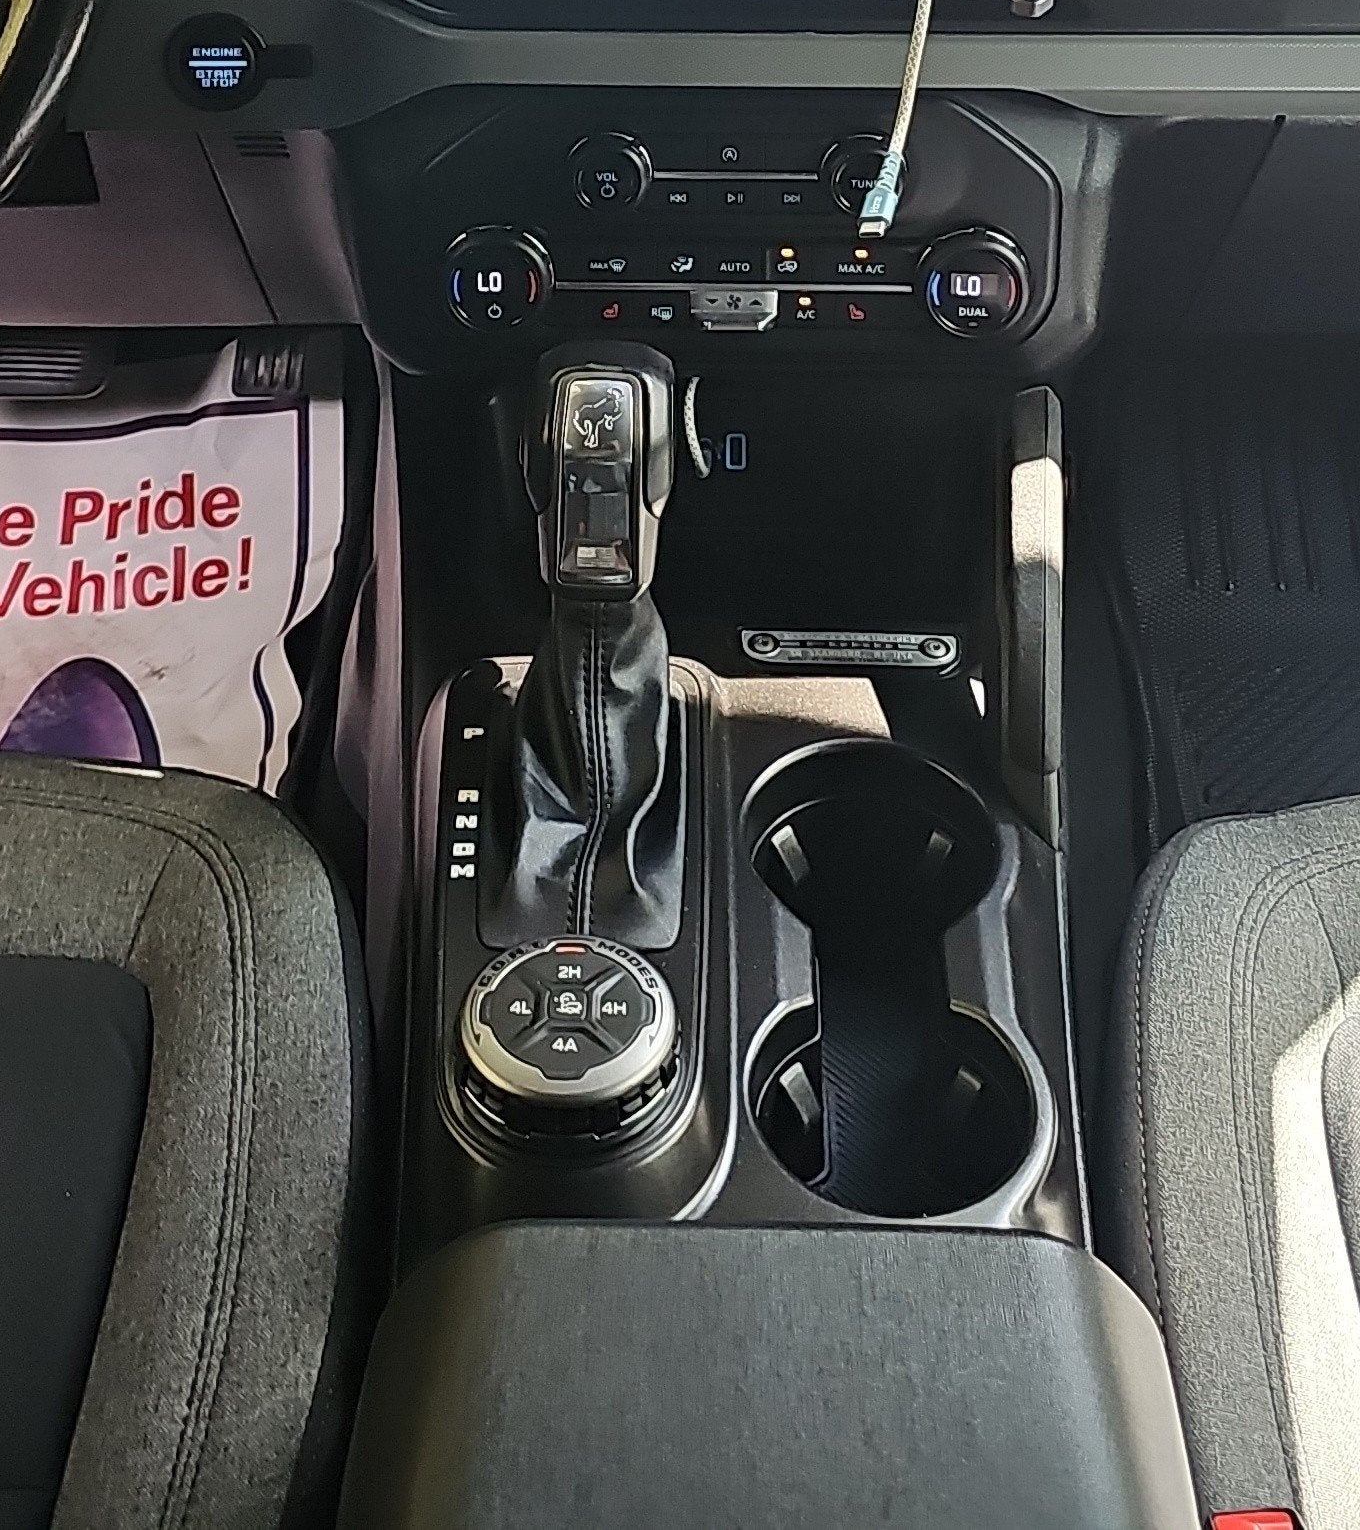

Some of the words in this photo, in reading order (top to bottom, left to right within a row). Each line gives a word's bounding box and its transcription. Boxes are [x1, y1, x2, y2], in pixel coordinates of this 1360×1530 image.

[192, 47, 243, 57] ENGINE
[195, 69, 243, 79] START
[201, 78, 239, 88] STOP
[596, 172, 619, 182] VOL
[851, 179, 878, 189] TUN
[719, 262, 750, 272] AUTO
[838, 263, 863, 274] MAX
[865, 263, 885, 274] A/C
[477, 271, 502, 293] LO
[955, 275, 981, 297] LO
[796, 309, 816, 320] A/C
[958, 306, 989, 317] DUAL
[59, 472, 242, 546] Pride
[463, 727, 485, 740] P
[455, 814, 478, 829] N
[452, 842, 476, 857] D
[450, 863, 475, 879] M
[597, 940, 660, 989] MODES
[557, 965, 582, 979] 2H
[509, 1000, 533, 1015] 4L
[601, 1001, 627, 1016] 4H
[551, 1037, 579, 1053] 4A
